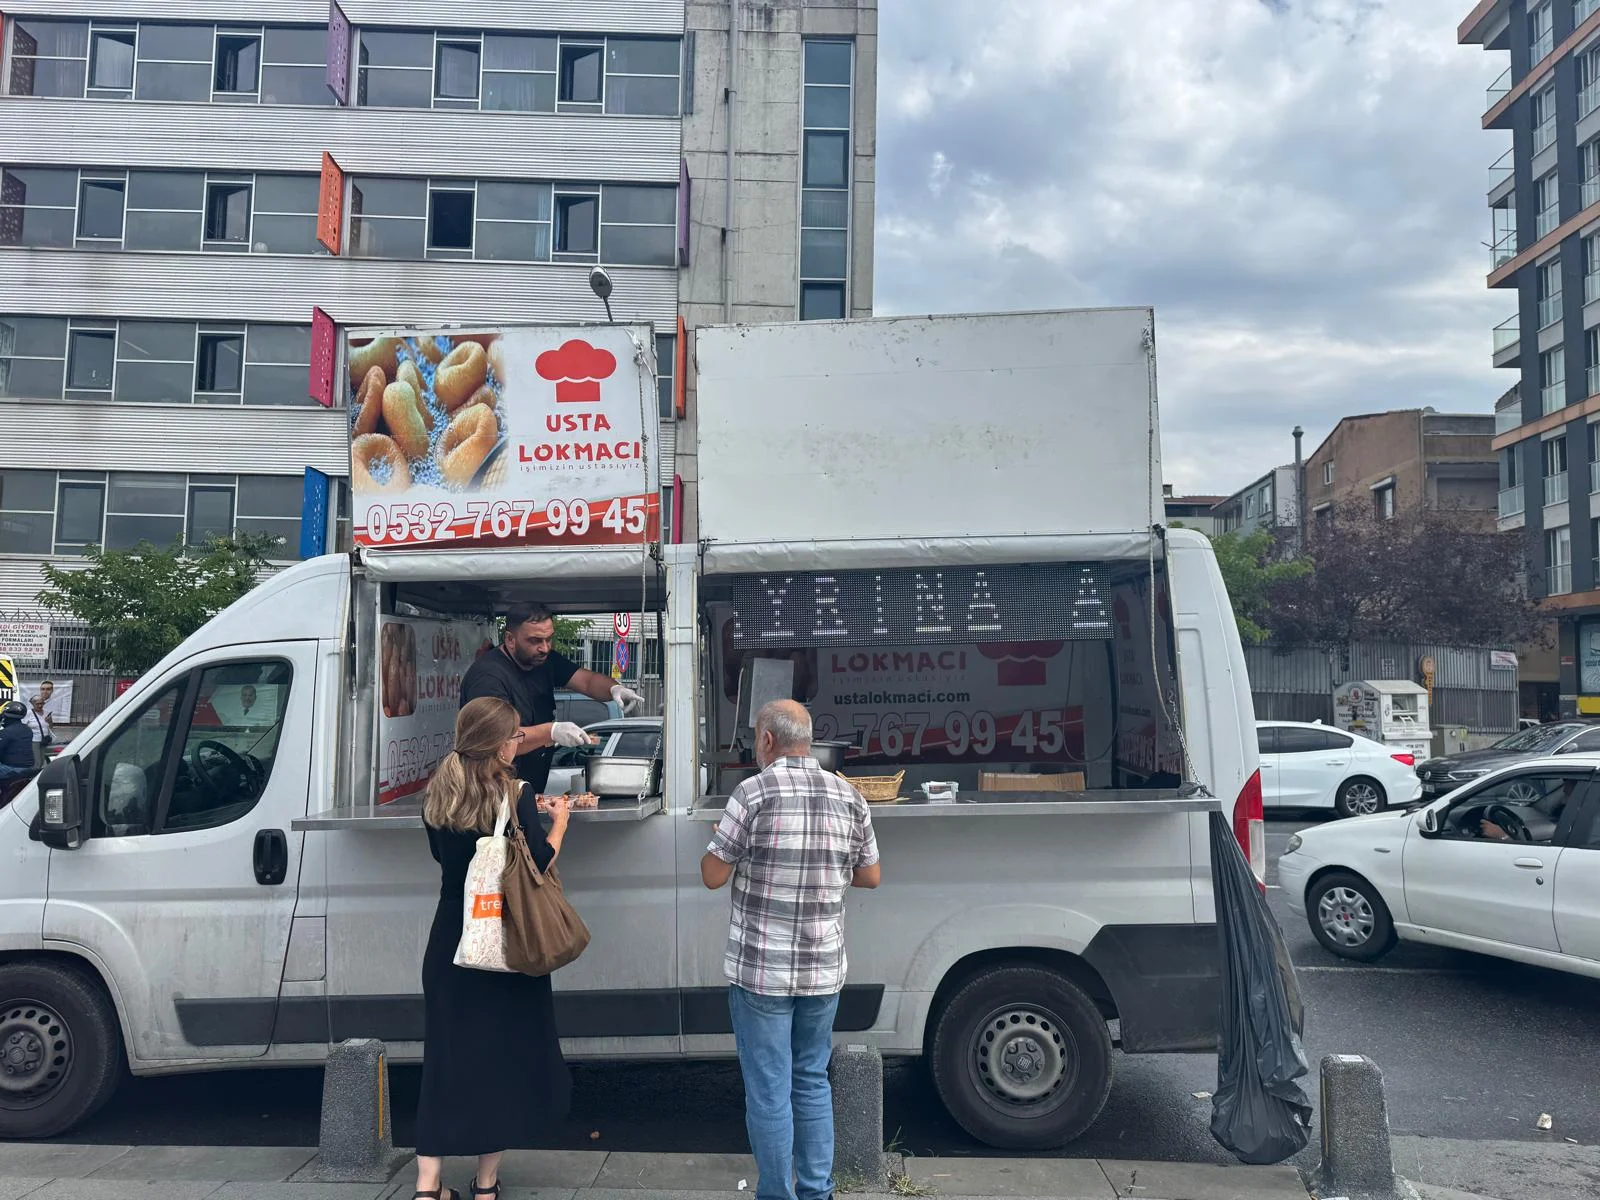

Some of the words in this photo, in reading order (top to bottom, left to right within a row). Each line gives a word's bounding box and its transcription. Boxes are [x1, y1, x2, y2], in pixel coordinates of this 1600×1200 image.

[546, 413, 611, 432] USTA
[519, 441, 640, 462] LOKMACI
[367, 502, 456, 542] 0532
[467, 499, 535, 539] 767
[546, 498, 590, 536] 99
[602, 497, 646, 534] 45
[733, 573, 1002, 637] YRINA
[616, 613, 628, 628] 30
[831, 651, 968, 673] LOKMACI
[833, 689, 971, 705] ustalokmaci.com
[853, 711, 931, 757] 767
[945, 710, 996, 756] 99
[1011, 709, 1065, 754] 45
[480, 899, 501, 911] tre
